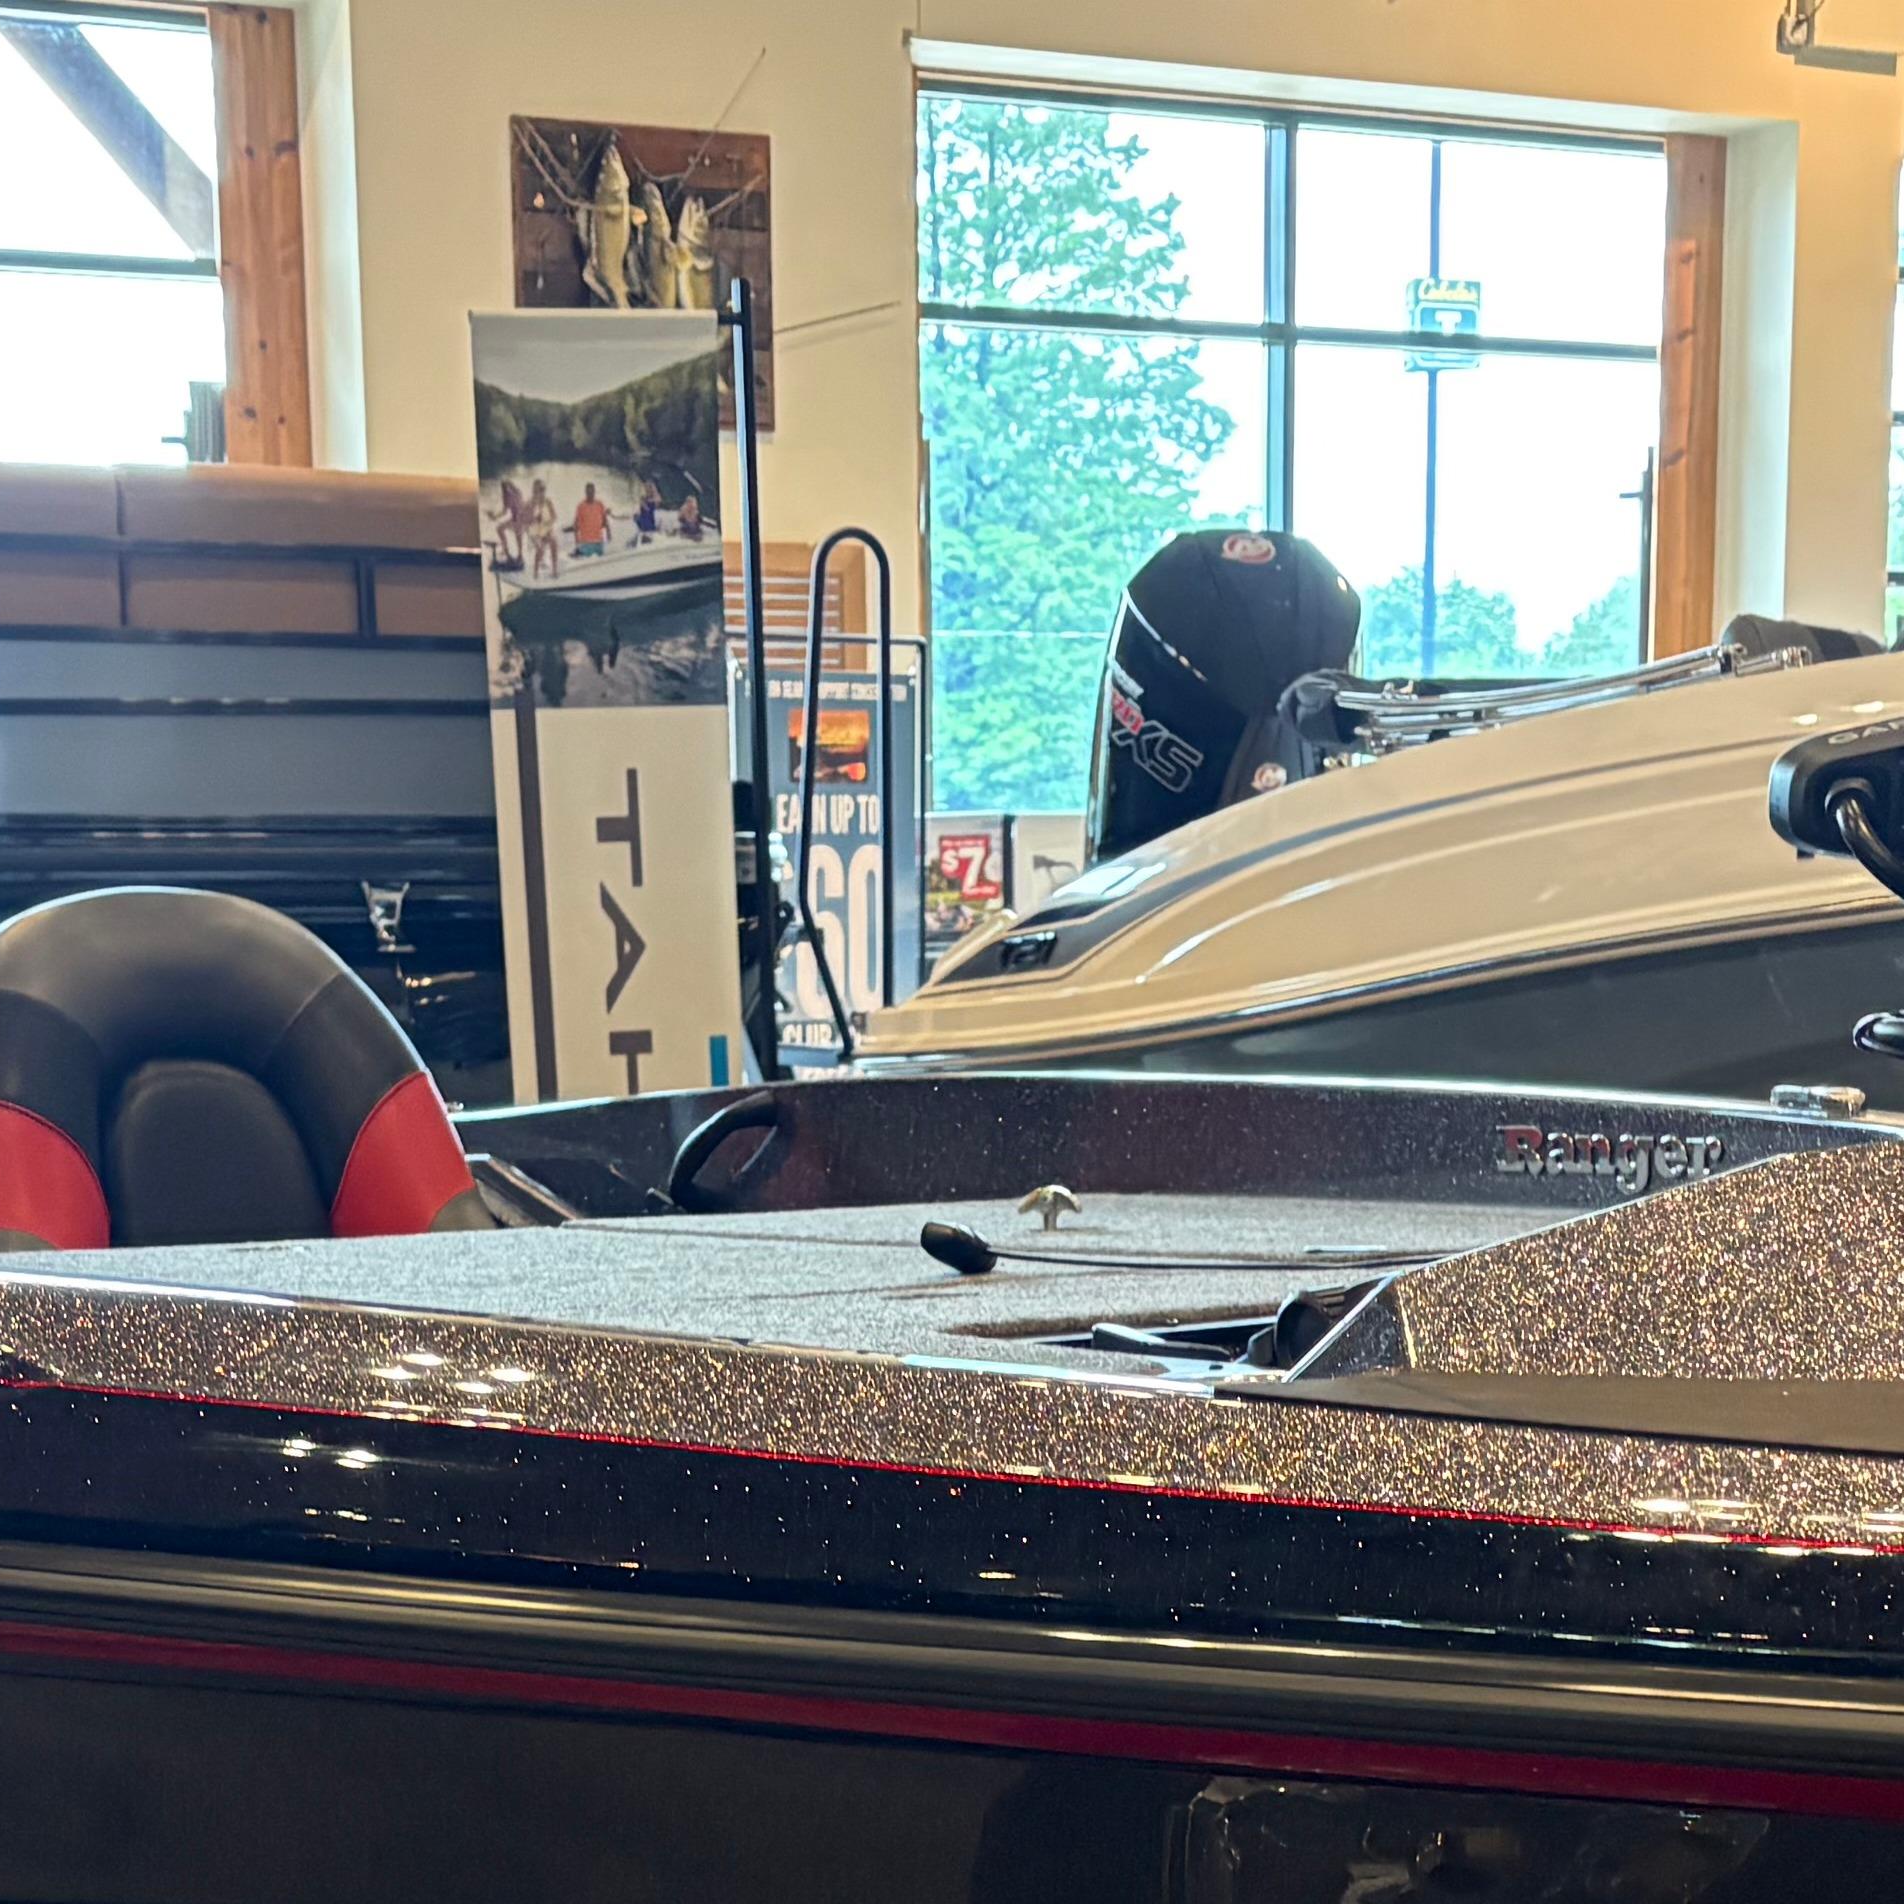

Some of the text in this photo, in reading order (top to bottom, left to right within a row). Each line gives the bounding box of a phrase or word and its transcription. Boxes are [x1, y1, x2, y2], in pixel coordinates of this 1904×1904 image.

[776, 794, 879, 834] EAN UP TO
[780, 844, 884, 1020] 60
[1496, 1124, 1724, 1195] Ranger
